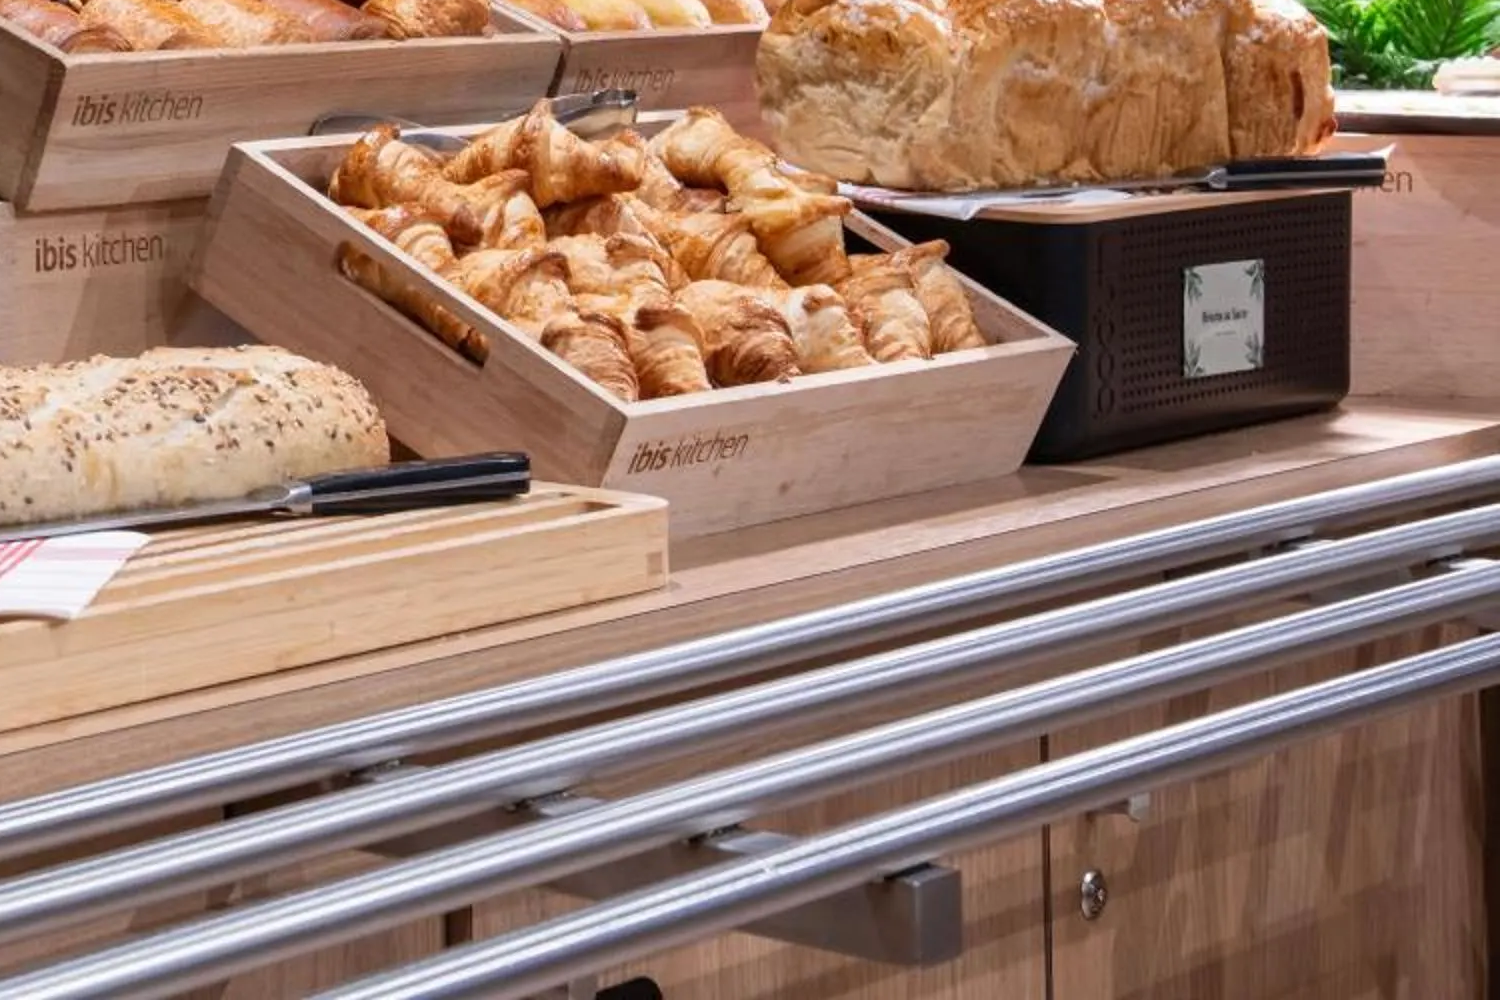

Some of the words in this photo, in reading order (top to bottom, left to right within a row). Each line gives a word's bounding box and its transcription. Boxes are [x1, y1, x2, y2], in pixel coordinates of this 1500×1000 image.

[71, 94, 117, 127] ibis
[118, 89, 203, 125] kitchen
[35, 236, 77, 273] ibis
[82, 230, 164, 268] kitchen
[626, 440, 673, 475] ibis
[670, 427, 750, 469] kitchen
